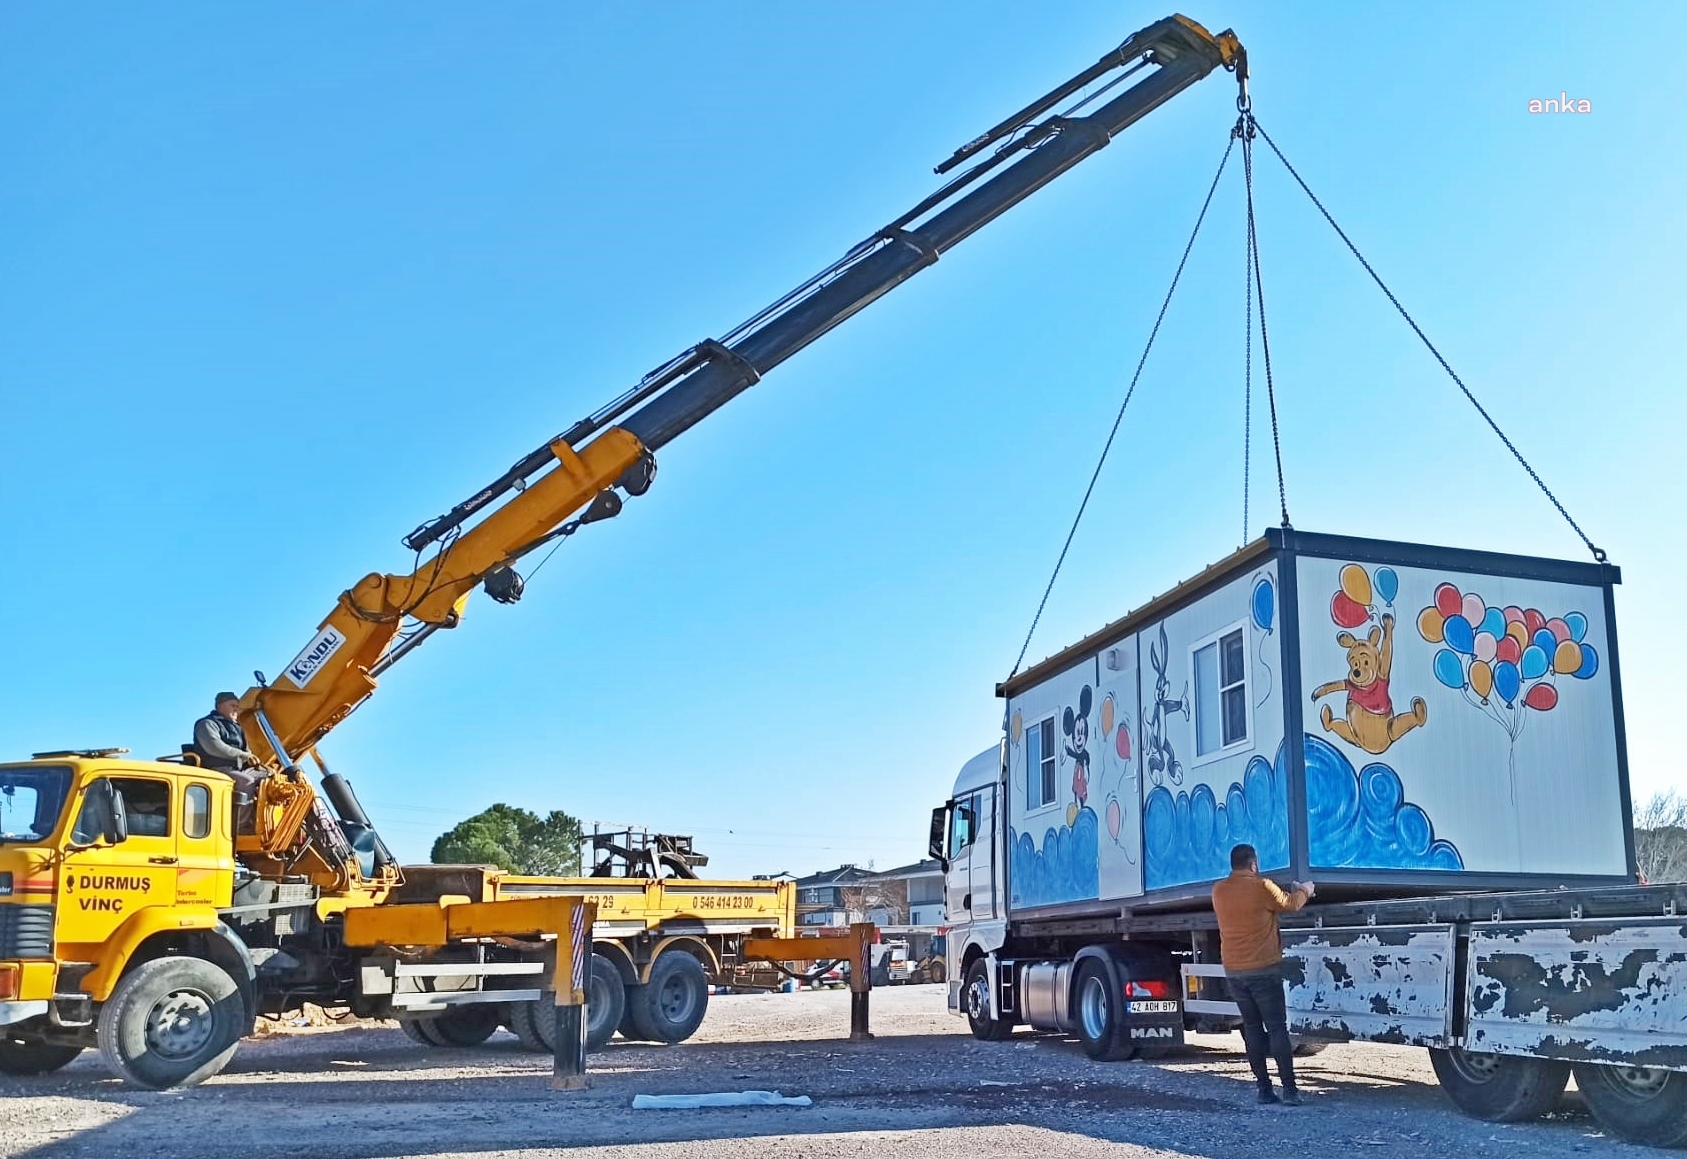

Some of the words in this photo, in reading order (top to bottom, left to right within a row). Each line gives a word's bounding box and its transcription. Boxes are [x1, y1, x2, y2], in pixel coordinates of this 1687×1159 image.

[80, 875, 151, 894] DURMUŞ
[79, 895, 123, 914] VİNÇ
[602, 895, 614, 909] 29
[692, 896, 698, 909] 0
[700, 896, 715, 909] 546
[716, 896, 731, 909] 414
[732, 896, 743, 909] 23
[743, 896, 754, 908] 00
[1131, 1002, 1141, 1012] 42
[1162, 1002, 1176, 1011] 817
[1130, 1027, 1173, 1039] MAN
